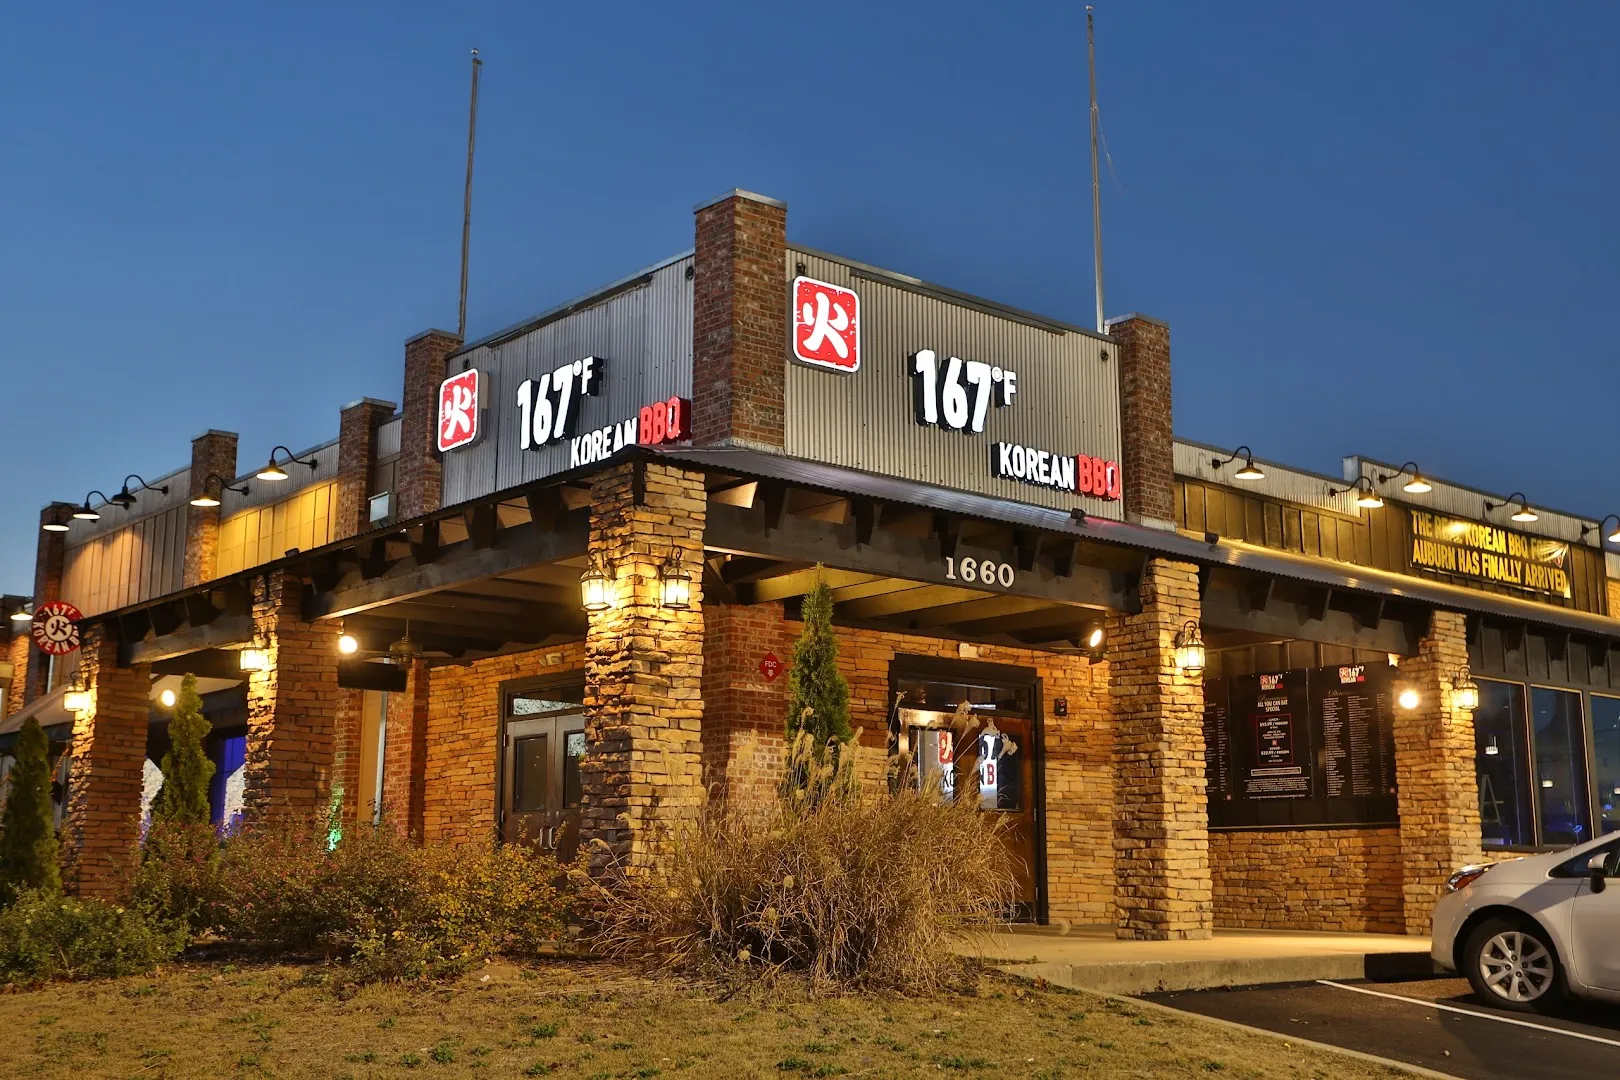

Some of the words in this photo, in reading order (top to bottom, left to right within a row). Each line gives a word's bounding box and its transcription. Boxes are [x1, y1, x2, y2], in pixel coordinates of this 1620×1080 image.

[516, 356, 593, 451] 167°F
[915, 349, 1017, 433] 167°F
[570, 416, 639, 469] KOREAN
[639, 395, 681, 445] BBQ
[998, 441, 1076, 491] KOREAN
[1076, 453, 1121, 501] BBQ
[1411, 509, 1433, 537] THE
[1463, 522, 1507, 554] KOREAN
[1508, 532, 1529, 559] BBQ
[1530, 538, 1551, 563] FO
[945, 557, 1015, 588] 1660
[1412, 538, 1456, 571] AUBURN
[1457, 548, 1480, 576] HAS
[1482, 553, 1522, 584] FINALLY
[1525, 563, 1567, 593] ARRIVED
[33, 621, 71, 653] KOREAN
[764, 660, 777, 668] FDC
